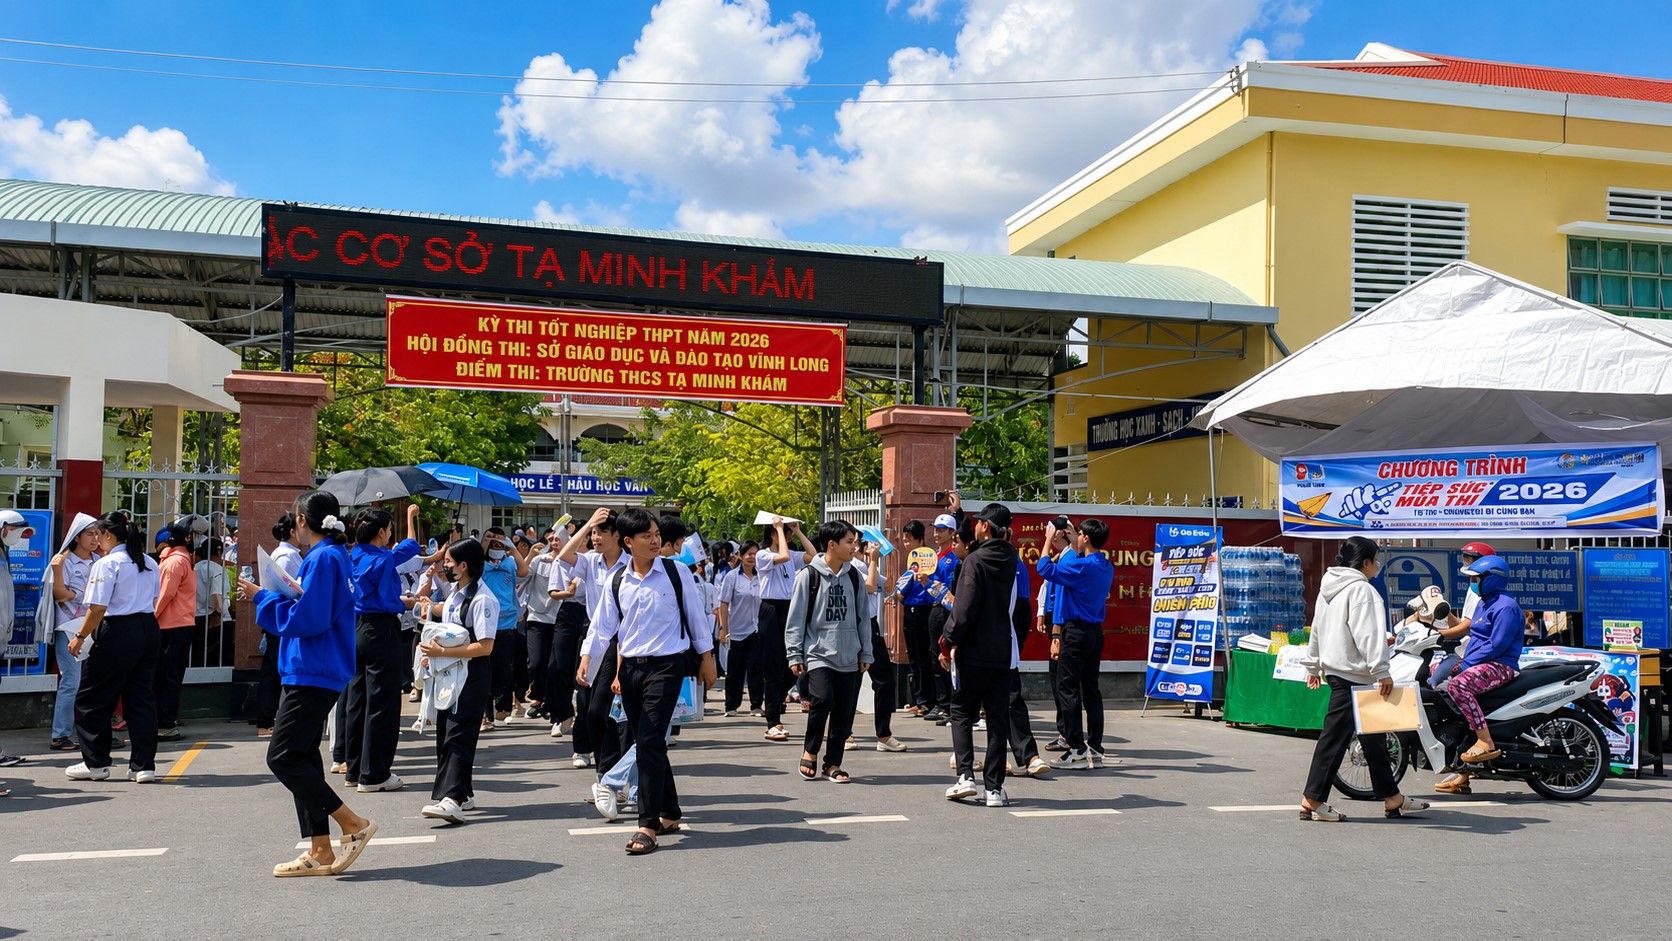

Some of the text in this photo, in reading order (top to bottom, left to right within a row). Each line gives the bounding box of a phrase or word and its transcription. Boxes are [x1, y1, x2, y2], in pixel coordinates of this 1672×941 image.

[335, 230, 410, 269] CƠ
[423, 230, 493, 275] SỞ
[506, 243, 566, 288] TẠ
[579, 250, 686, 291] MINH
[478, 314, 500, 333] KỲ
[506, 318, 533, 335] THI
[538, 317, 569, 337] TỐT
[574, 322, 638, 343] NGHIỆP
[643, 327, 683, 344] THPT
[730, 332, 770, 349] 2026
[407, 333, 437, 355] HỘI
[498, 341, 531, 358] THI:
[536, 339, 561, 358] SỞ
[565, 343, 605, 361] GIÁO
[610, 347, 644, 366] DỤC
[649, 346, 670, 365] VÀ
[675, 348, 708, 366] ĐÀO
[713, 352, 743, 371] TẠO
[790, 357, 830, 373] LONG
[507, 364, 540, 380] THI:
[545, 363, 614, 384] TRƯỜNG
[619, 369, 662, 386] THCS
[667, 372, 687, 390] TẠ
[692, 373, 736, 390] MINH
[741, 374, 788, 392] KHÁM
[1120, 418, 1134, 443] HỌC
[1135, 413, 1156, 437] XANH
[1162, 408, 1184, 437] SẠCH
[1378, 455, 1528, 479] CHƯƠNG TRÌNH
[510, 477, 535, 492] HỌC
[567, 476, 592, 493] HẬU
[1498, 481, 1588, 501] 2026
[1445, 494, 1480, 507] THI
[825, 608, 848, 622] DAY
